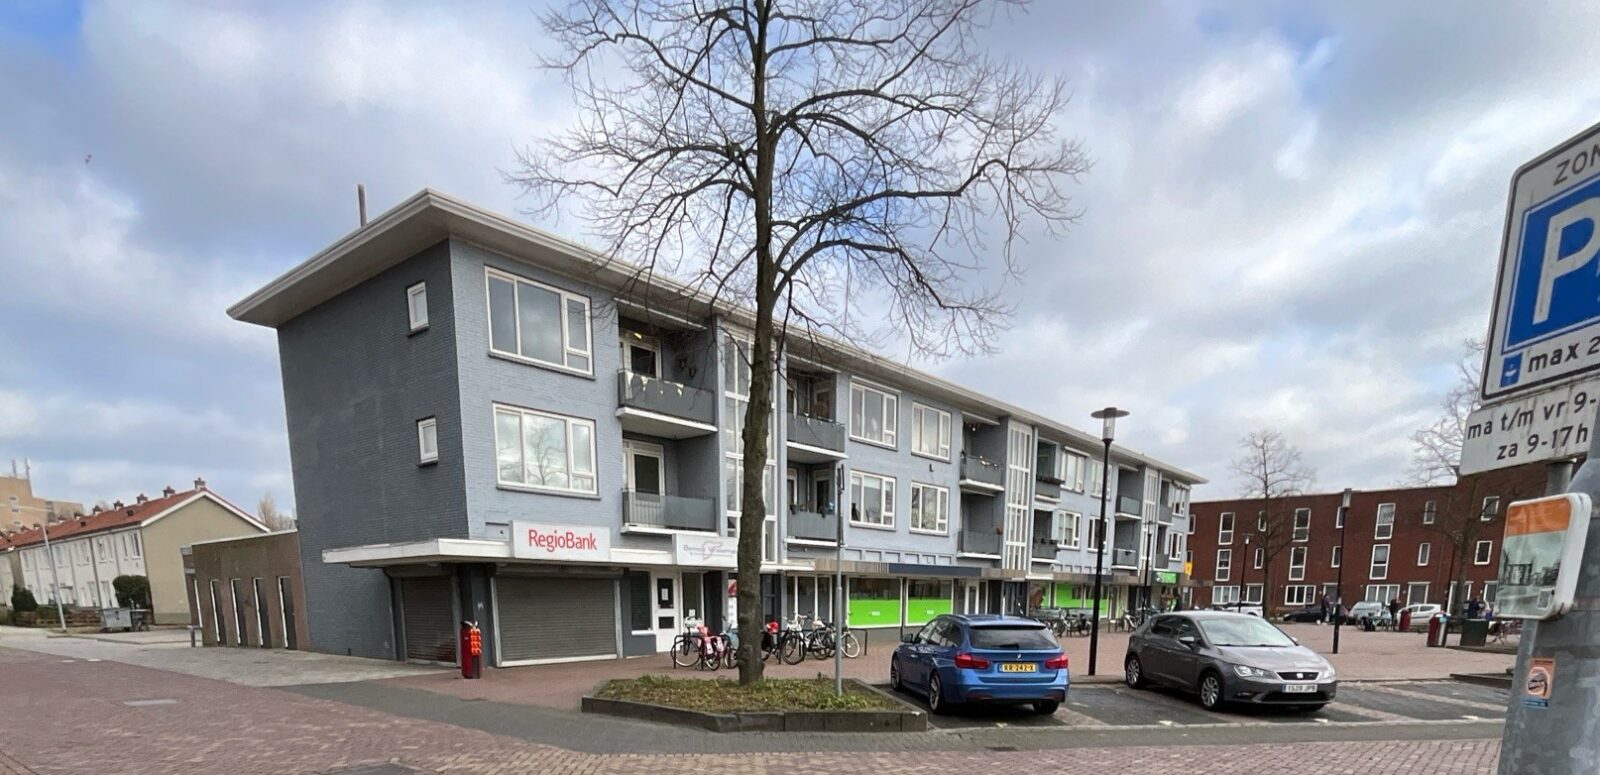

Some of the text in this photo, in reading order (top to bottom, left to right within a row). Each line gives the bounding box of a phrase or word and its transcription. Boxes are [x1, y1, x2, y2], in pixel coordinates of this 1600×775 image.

[1532, 197, 1600, 326] P
[1528, 343, 1580, 373] max
[1467, 420, 1493, 440] ma
[1501, 407, 1534, 431] t/m
[1543, 401, 1567, 420] vr
[1497, 443, 1519, 461] za
[528, 528, 598, 553] RegioBank
